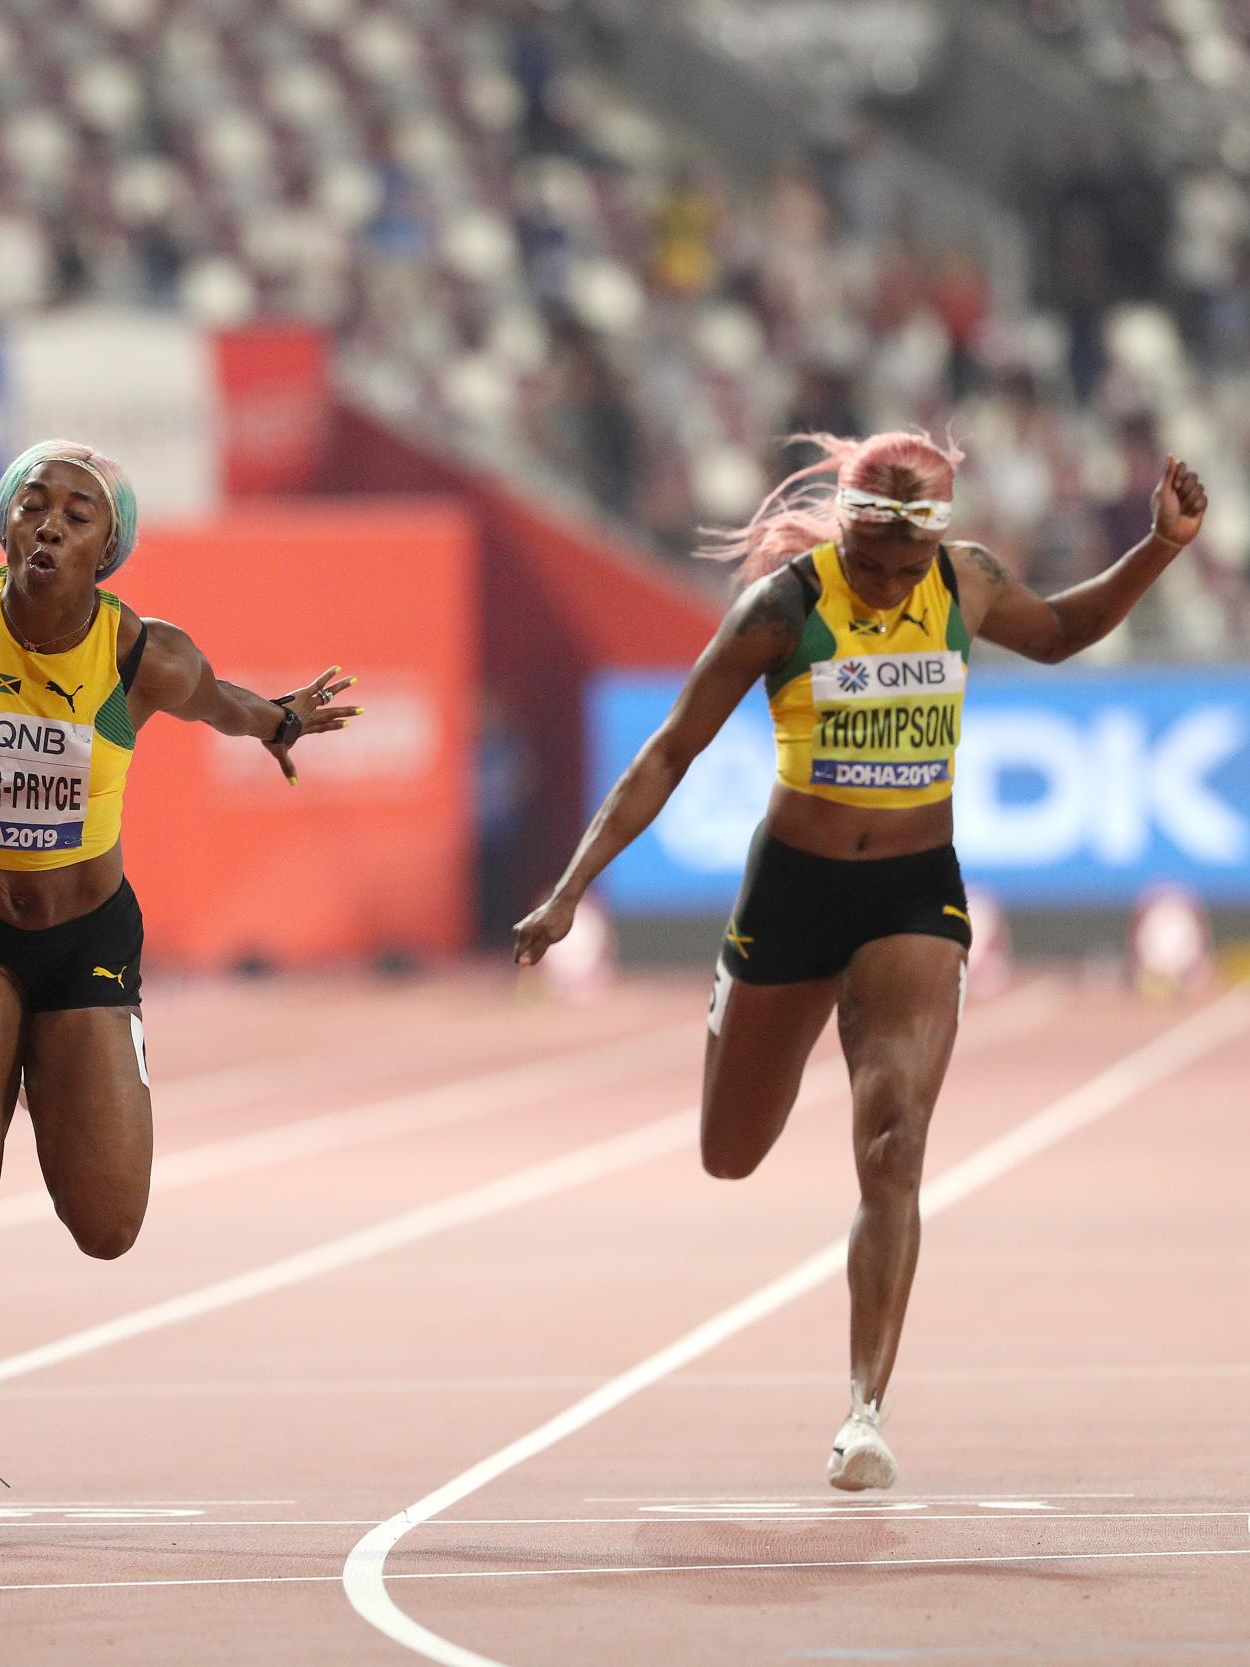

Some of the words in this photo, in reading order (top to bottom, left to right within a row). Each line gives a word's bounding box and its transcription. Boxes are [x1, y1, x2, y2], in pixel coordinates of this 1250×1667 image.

[877, 660, 946, 688] QNB
[820, 704, 956, 750] THOMPSON
[955, 703, 1250, 866] DK
